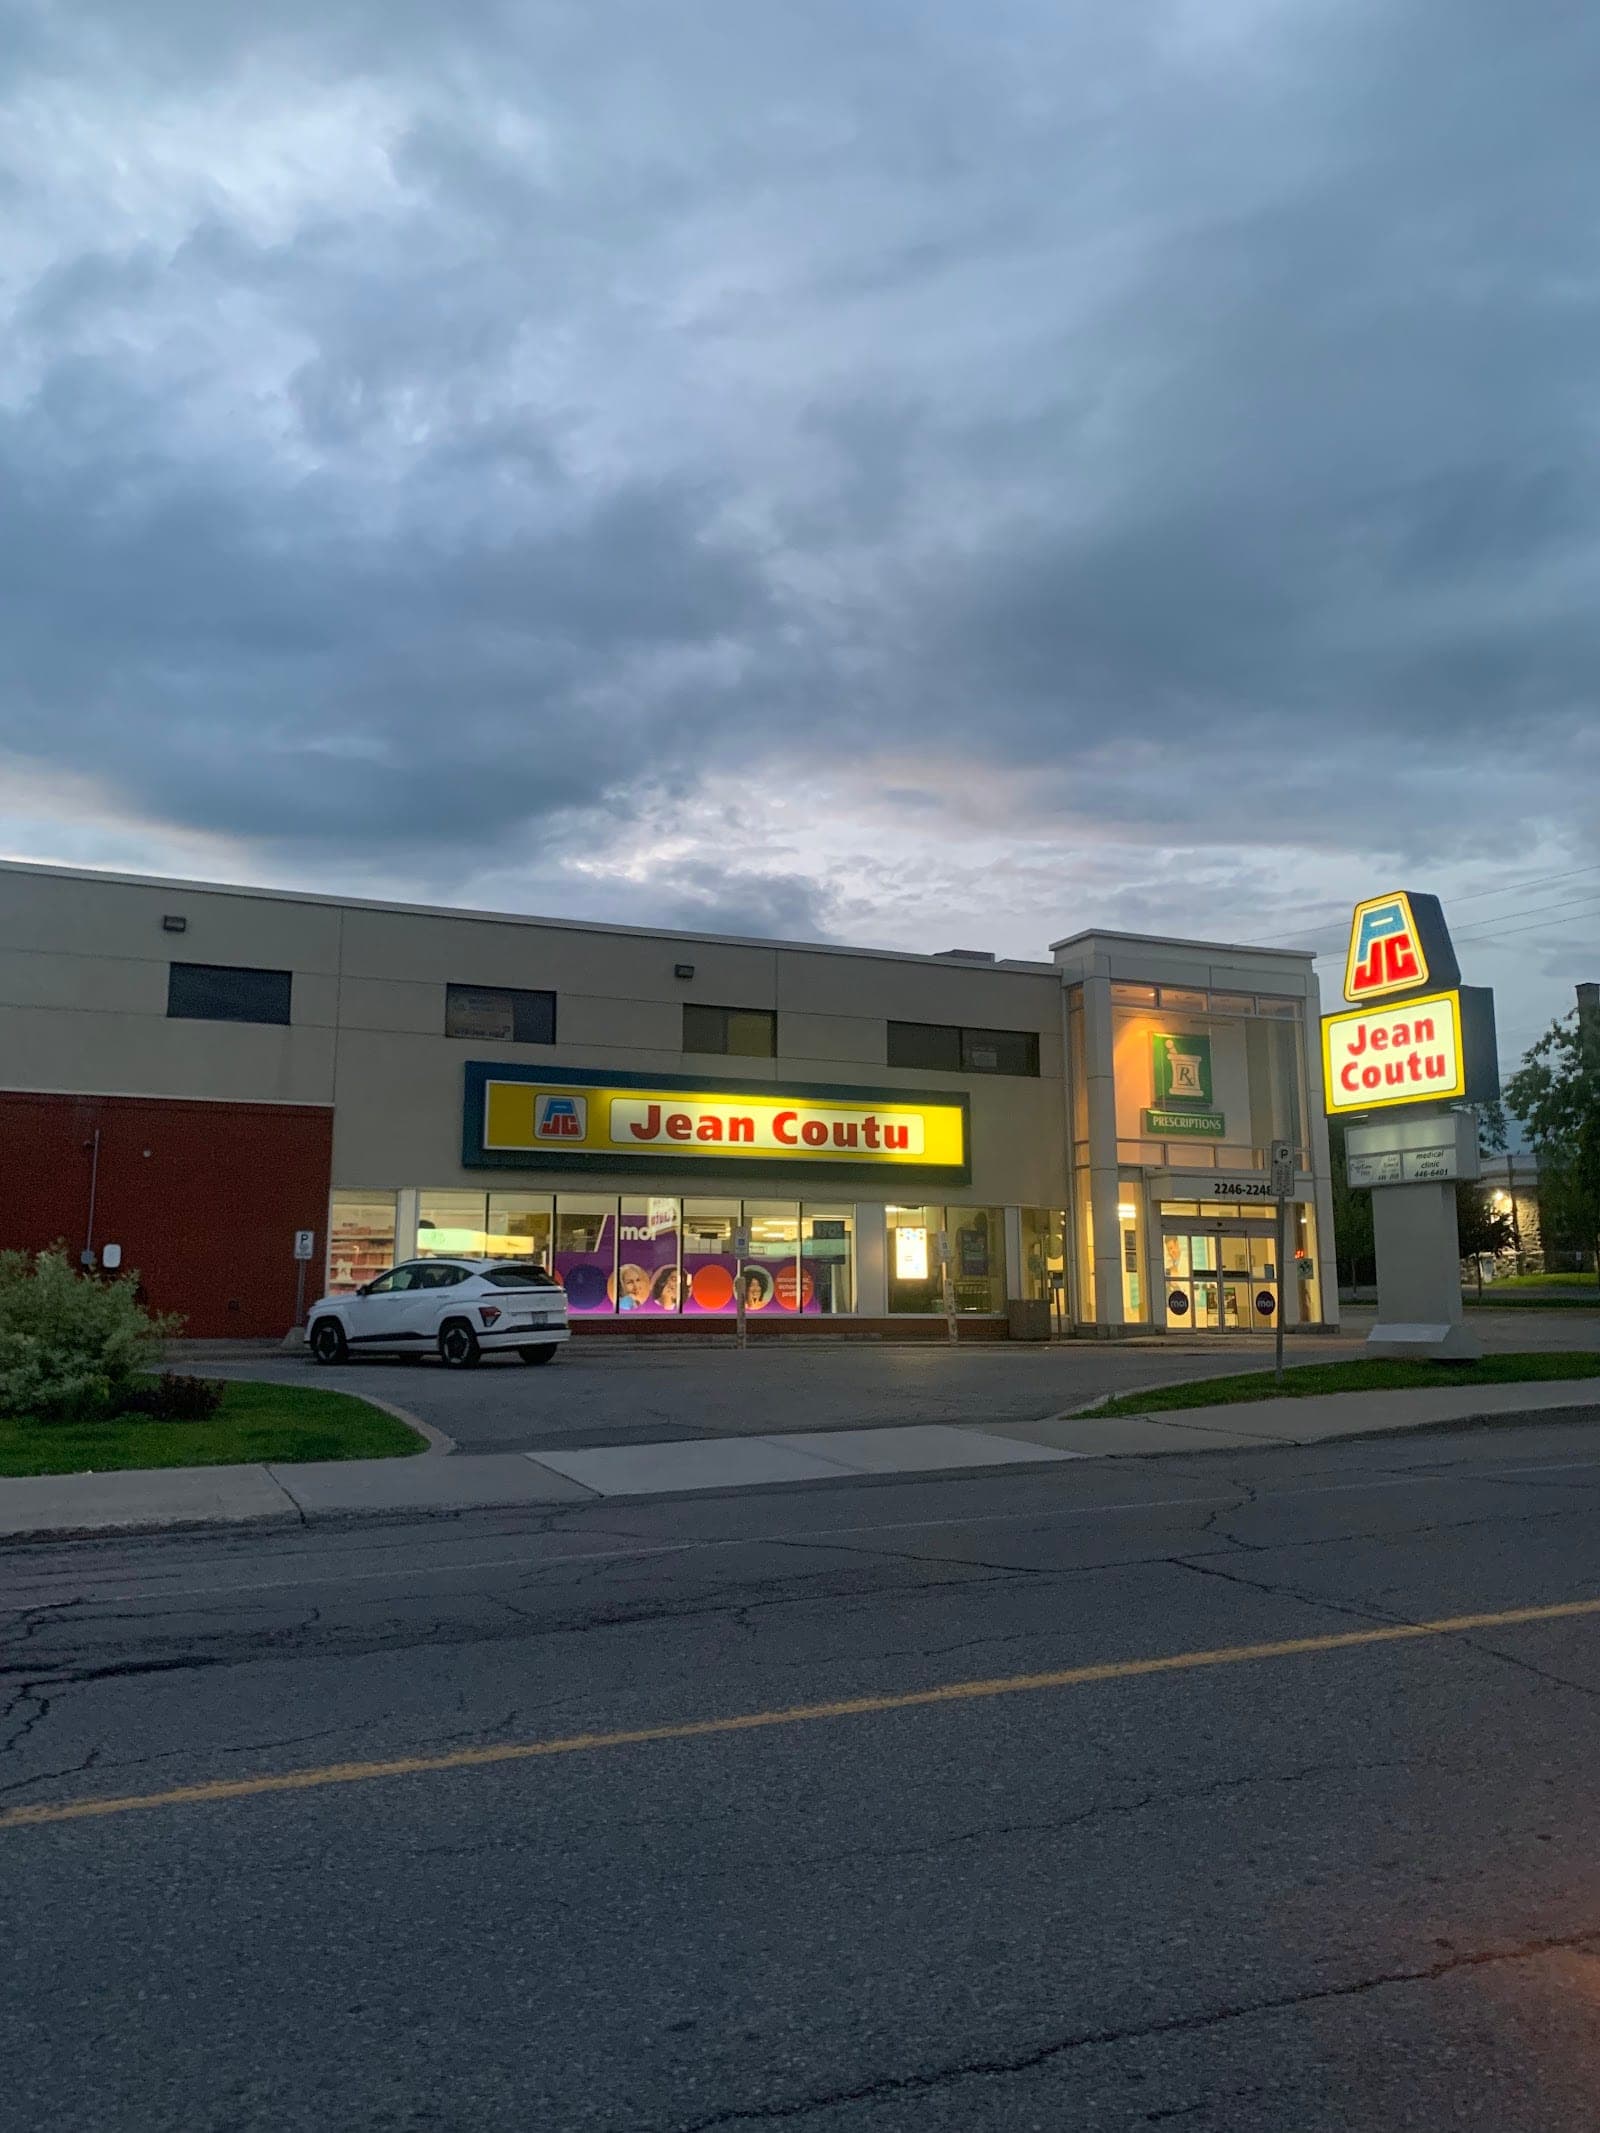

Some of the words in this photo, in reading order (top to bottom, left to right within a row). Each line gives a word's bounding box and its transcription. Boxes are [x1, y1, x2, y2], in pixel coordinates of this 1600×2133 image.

[1347, 1018, 1435, 1056] Jean
[1340, 1051, 1446, 1092] Coutu
[630, 1104, 755, 1143] Jean
[773, 1111, 909, 1149] Coutu
[1152, 1115, 1222, 1130] PRESCRIPTIONS
[1281, 1149, 1288, 1159] P
[1416, 1150, 1444, 1160] medical
[1421, 1161, 1440, 1169] clinic
[300, 1233, 309, 1245] P
[1170, 1299, 1187, 1307] moi
[1257, 1299, 1273, 1307] moi
